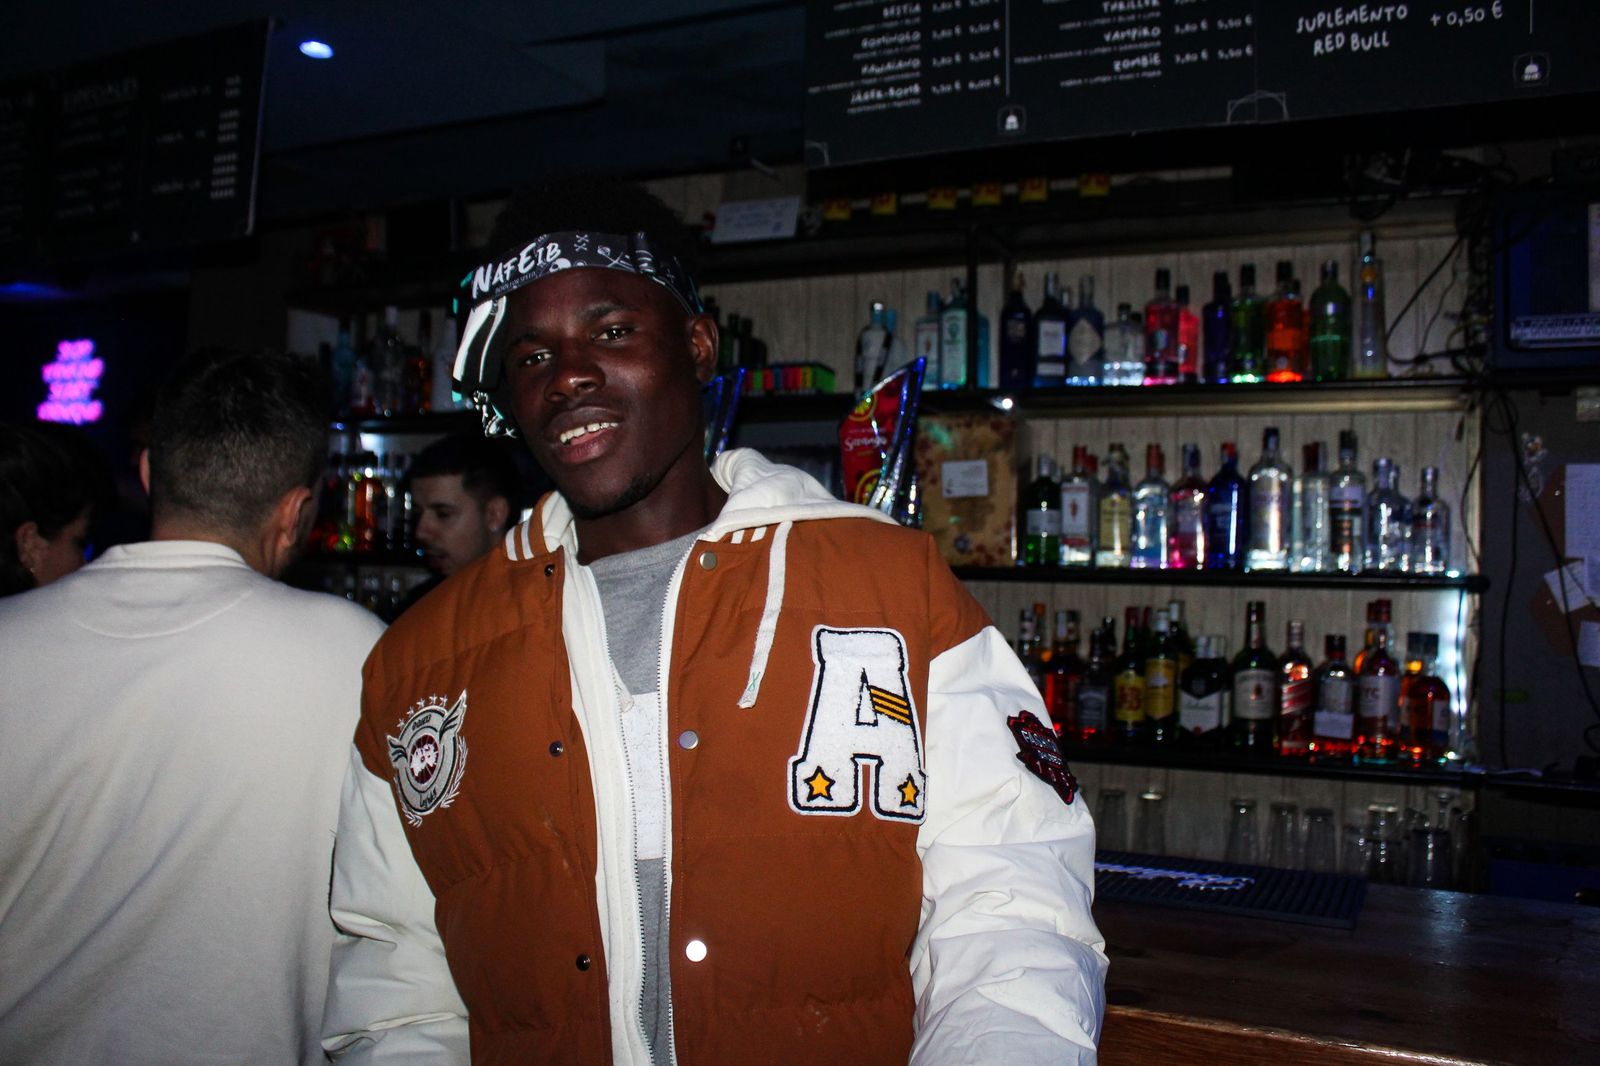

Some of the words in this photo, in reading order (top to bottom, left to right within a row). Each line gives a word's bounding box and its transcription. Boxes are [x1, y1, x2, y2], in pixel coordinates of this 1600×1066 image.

[1296, 4, 1408, 34] SUPLEMENTO
[1446, 7, 1486, 27] 0,50
[1103, 26, 1161, 42] VAMPIRO
[1312, 32, 1346, 56] RED
[1350, 30, 1390, 52] BULL
[1112, 52, 1161, 73] ZOMBIE
